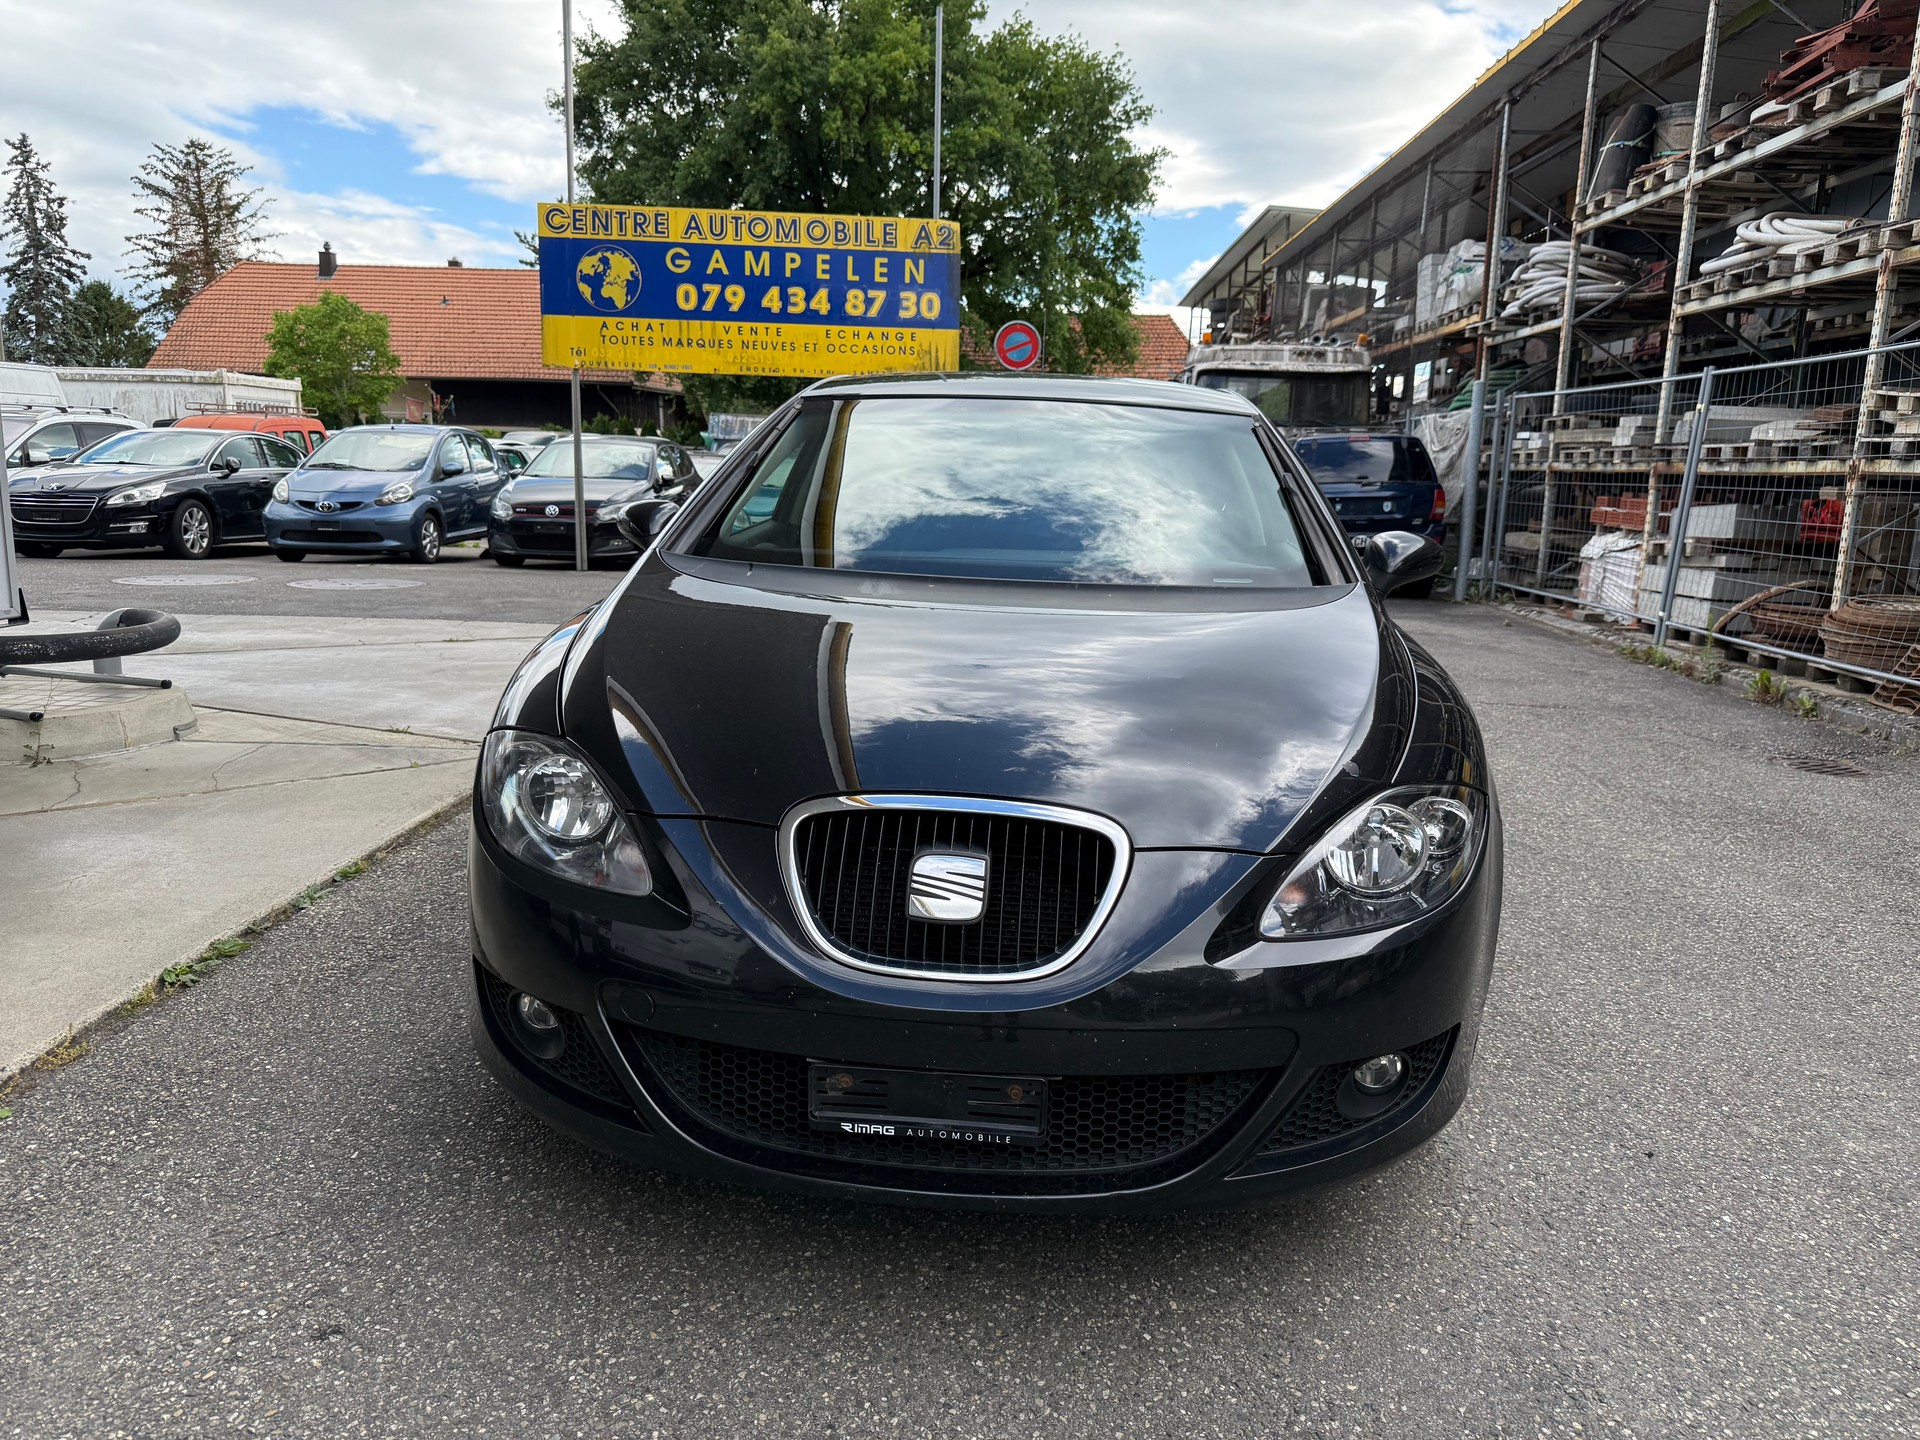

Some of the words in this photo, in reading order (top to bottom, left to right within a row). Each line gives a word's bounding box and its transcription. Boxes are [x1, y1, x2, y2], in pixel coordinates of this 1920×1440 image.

[543, 206, 669, 238] CENTRE
[681, 211, 897, 249] AUTOMOBILE
[911, 222, 955, 250] A2
[665, 247, 925, 285] GAMPELEN
[676, 283, 746, 312] 079
[761, 286, 831, 316] 434
[844, 289, 887, 318] 87
[899, 291, 941, 319] 30
[600, 320, 666, 333] ACHAT
[722, 325, 783, 337] VENTE
[825, 329, 917, 342] ECHANGE
[570, 347, 587, 357] Tél
[601, 334, 655, 347] TOUTES
[662, 337, 734, 349] MARQUES
[741, 340, 797, 351] NEUVES
[804, 342, 818, 353] ET
[826, 343, 916, 356] OCCASIONS
[906, 1128, 1012, 1144] AUTOMOBILE
